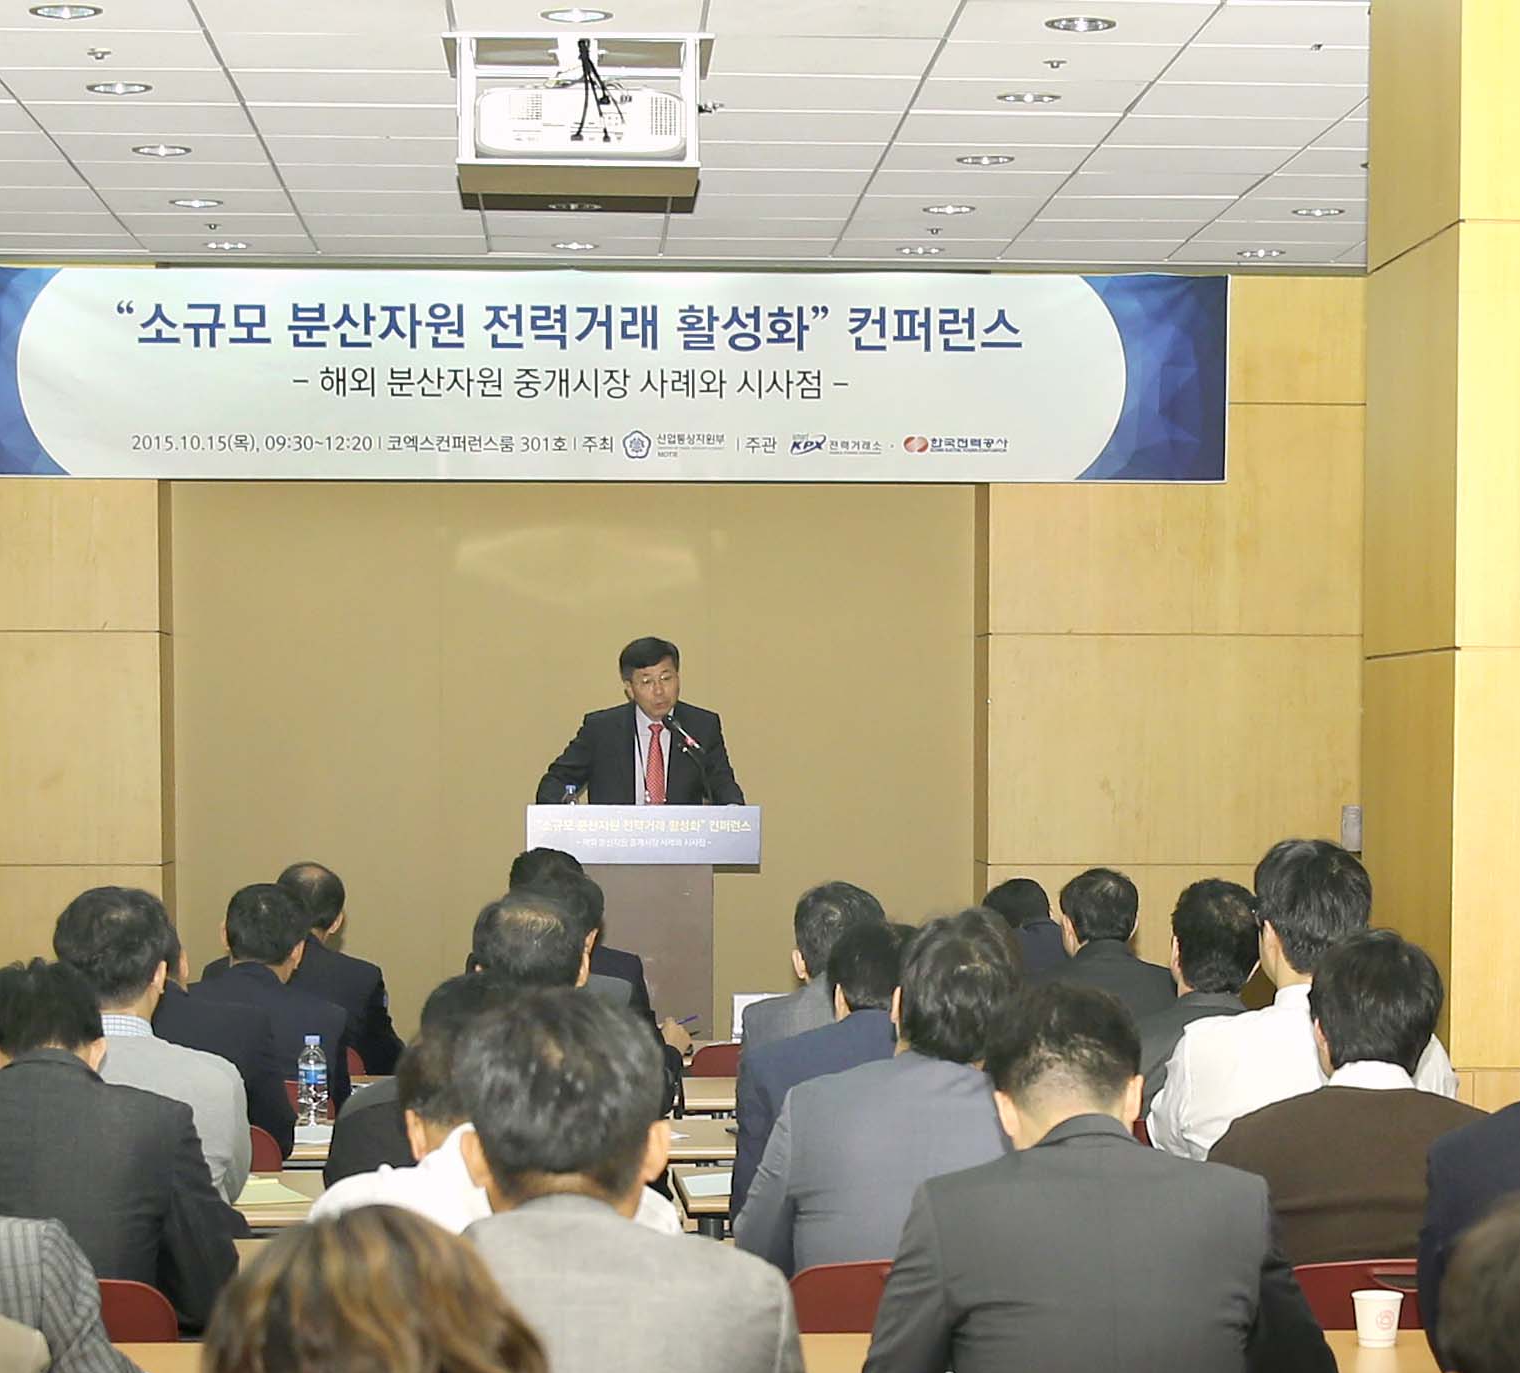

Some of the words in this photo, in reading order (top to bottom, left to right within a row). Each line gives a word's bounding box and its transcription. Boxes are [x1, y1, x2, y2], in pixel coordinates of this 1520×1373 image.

[116, 300, 272, 349] “소규모
[287, 302, 466, 350] 분산자원
[483, 303, 659, 351] 전력거래
[677, 304, 829, 352] 활성화”
[848, 306, 1023, 353] 컨퍼런스
[319, 366, 376, 398] 해외
[387, 367, 503, 398] 분산자원
[513, 367, 631, 399] 중개시장
[640, 368, 727, 400] 사례와
[736, 369, 822, 400] 시사점
[131, 434, 260, 453] 2015.10.15(목),
[265, 435, 372, 452] 09:30~12:20
[386, 434, 514, 453] 코엑스컨퍼런스룸
[520, 435, 568, 453] 301호
[582, 435, 614, 453] 주최
[745, 436, 777, 454] 주관
[791, 440, 824, 450] KPX
[930, 437, 1008, 448] 한국전력공사
